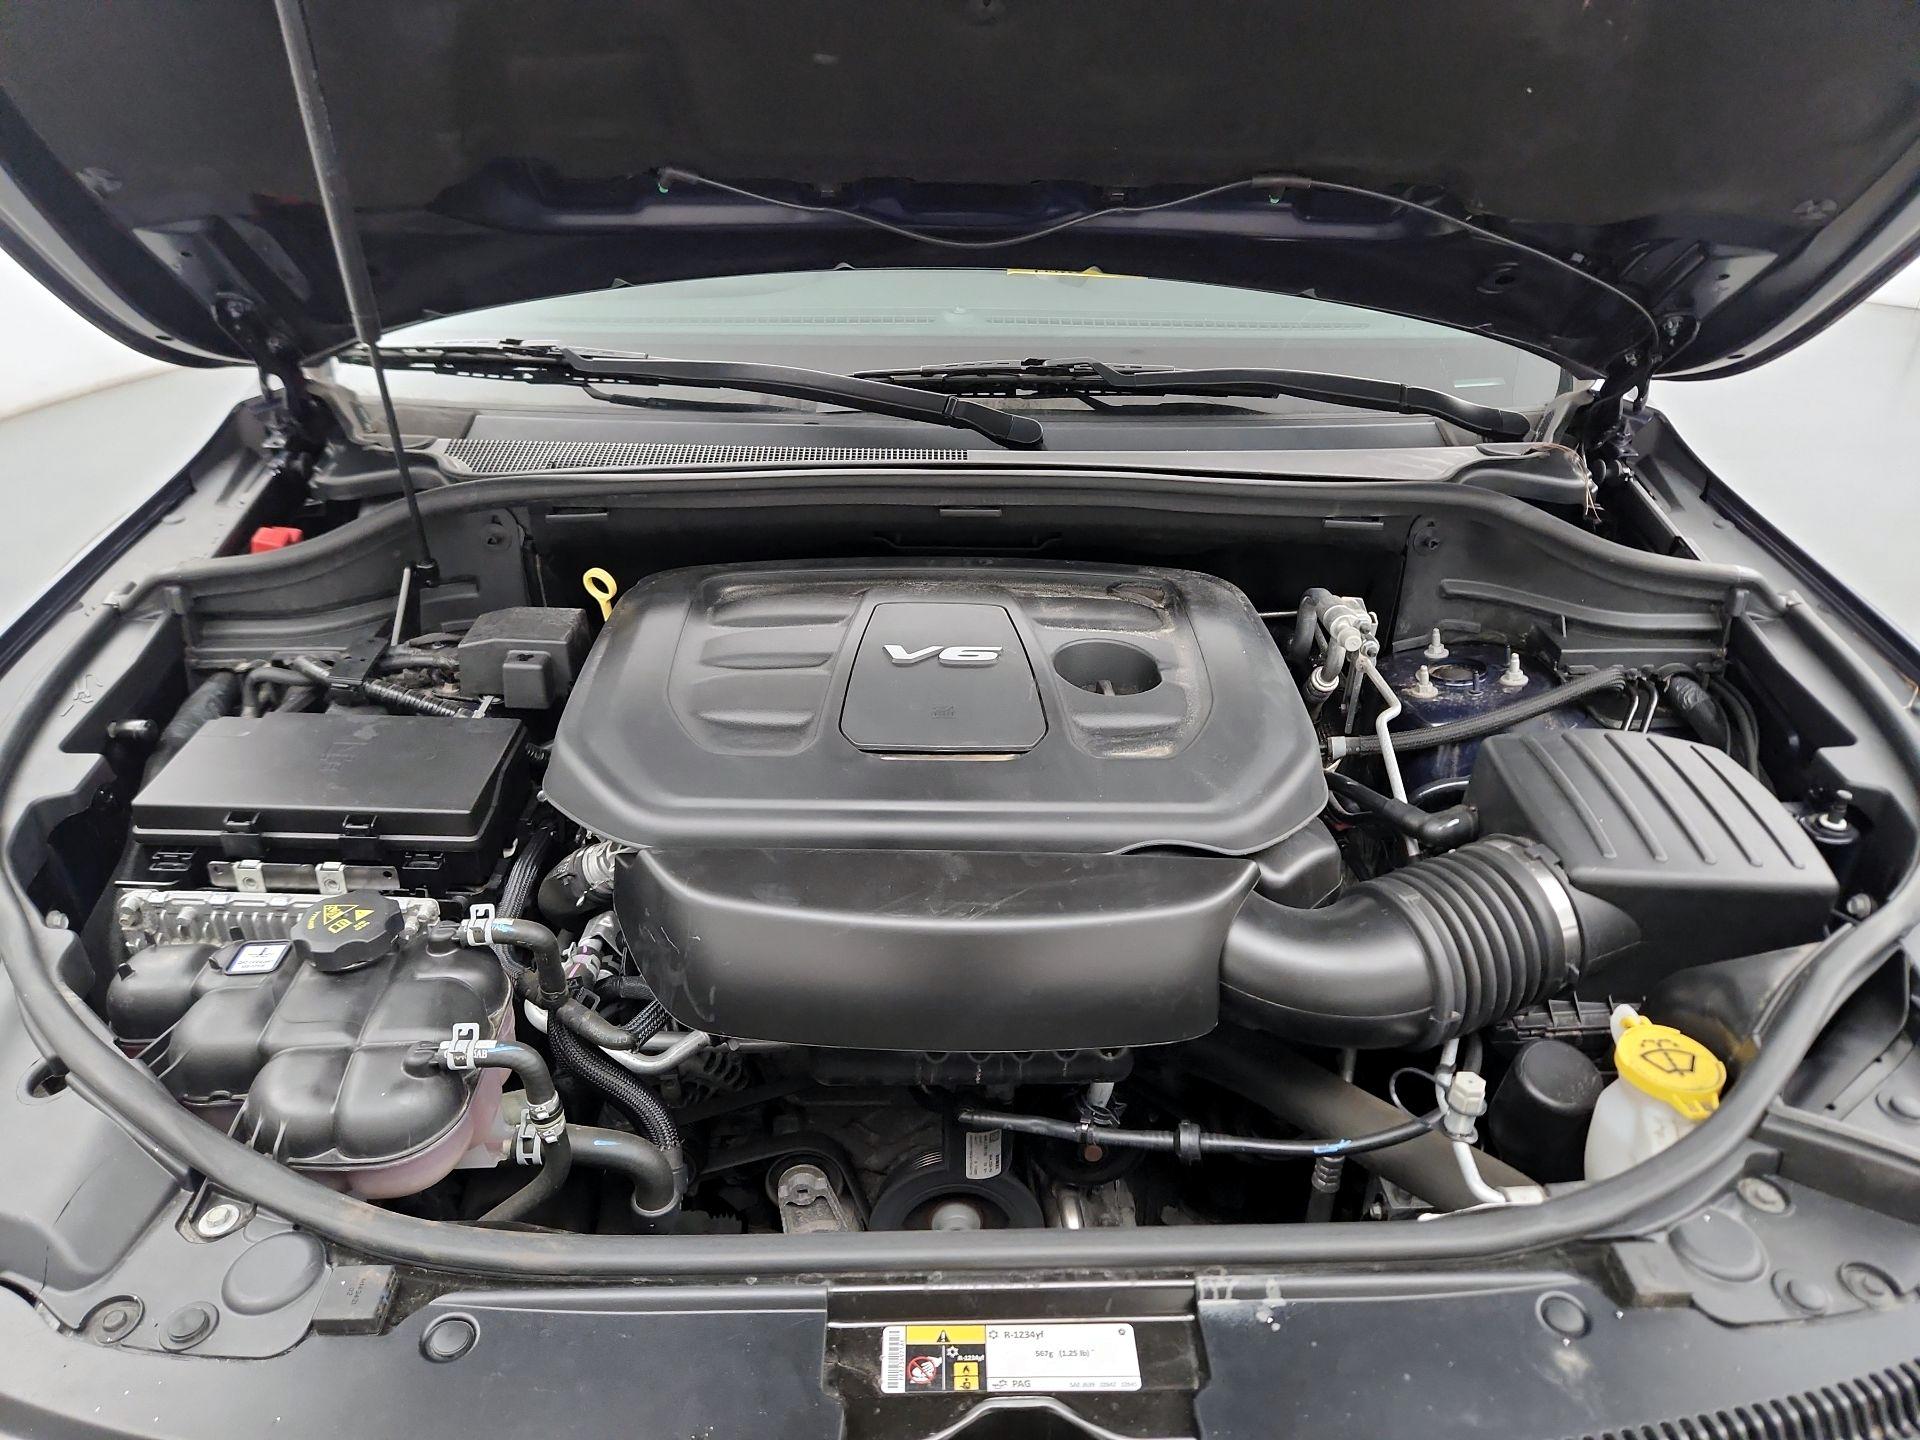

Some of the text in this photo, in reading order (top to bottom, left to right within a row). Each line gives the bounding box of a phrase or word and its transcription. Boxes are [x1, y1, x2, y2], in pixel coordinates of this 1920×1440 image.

[882, 644, 1003, 665] V6
[1004, 1330, 1044, 1340] R-1234yf
[1035, 1350, 1053, 1358] 567g
[1012, 1379, 1031, 1388] PAG
